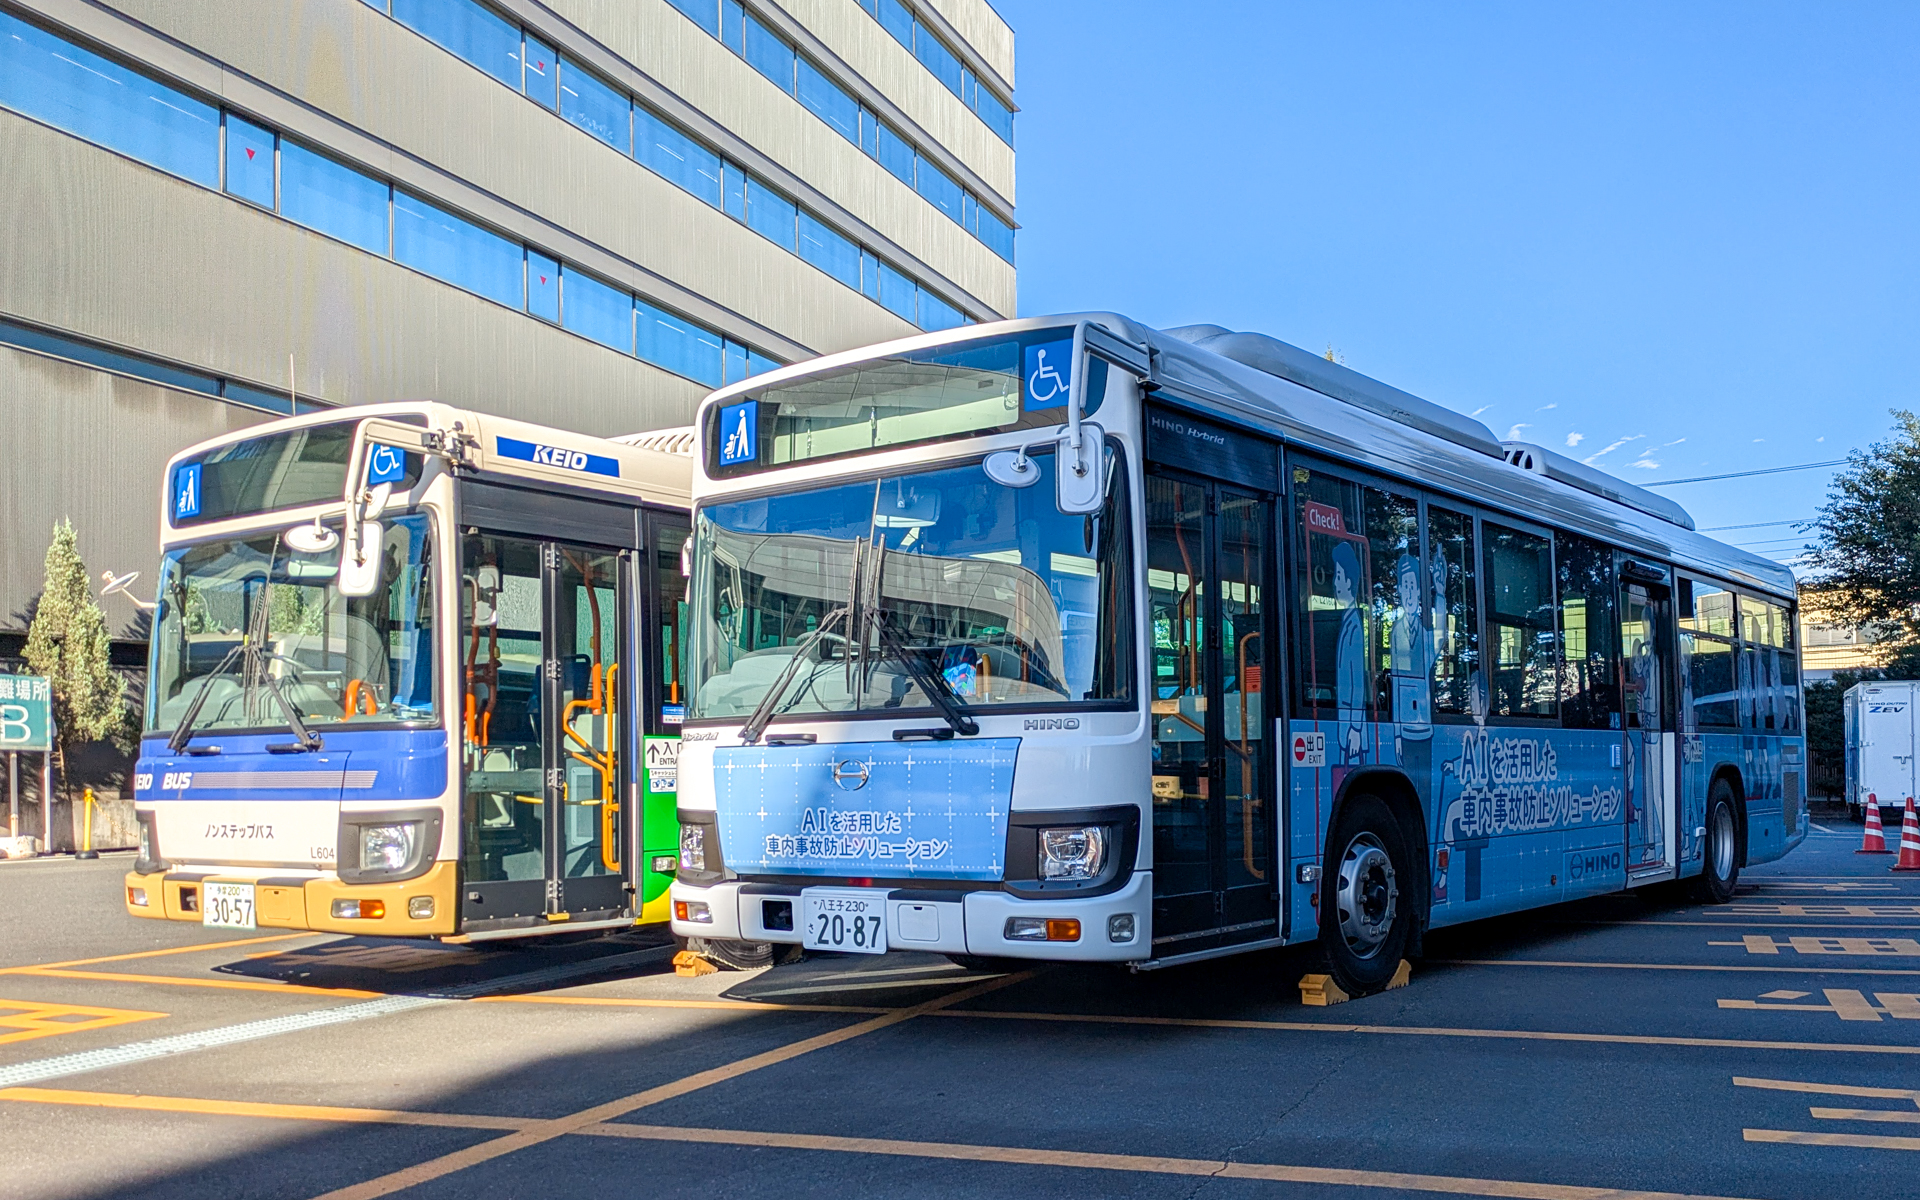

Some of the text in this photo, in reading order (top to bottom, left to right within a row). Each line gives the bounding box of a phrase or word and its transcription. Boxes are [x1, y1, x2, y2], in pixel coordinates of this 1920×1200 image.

[1151, 417, 1225, 445] HINO Hybrid
[532, 444, 588, 470] KEIO
[1309, 508, 1340, 531] Check!
[0, 704, 31, 743] B
[1024, 717, 1080, 731] HINO
[1307, 735, 1324, 751] 出口
[1309, 755, 1322, 763] EXIT
[1461, 732, 1557, 783] AIを活用した
[162, 772, 192, 790] BUS
[802, 808, 900, 833] AIを活用した
[1461, 785, 1621, 836] 車内事故防止ソリューション
[205, 824, 274, 839] ノンステップバス
[310, 847, 335, 859] L604
[766, 835, 948, 859] 車内事故防止ソリューション
[1585, 852, 1620, 873] HINO
